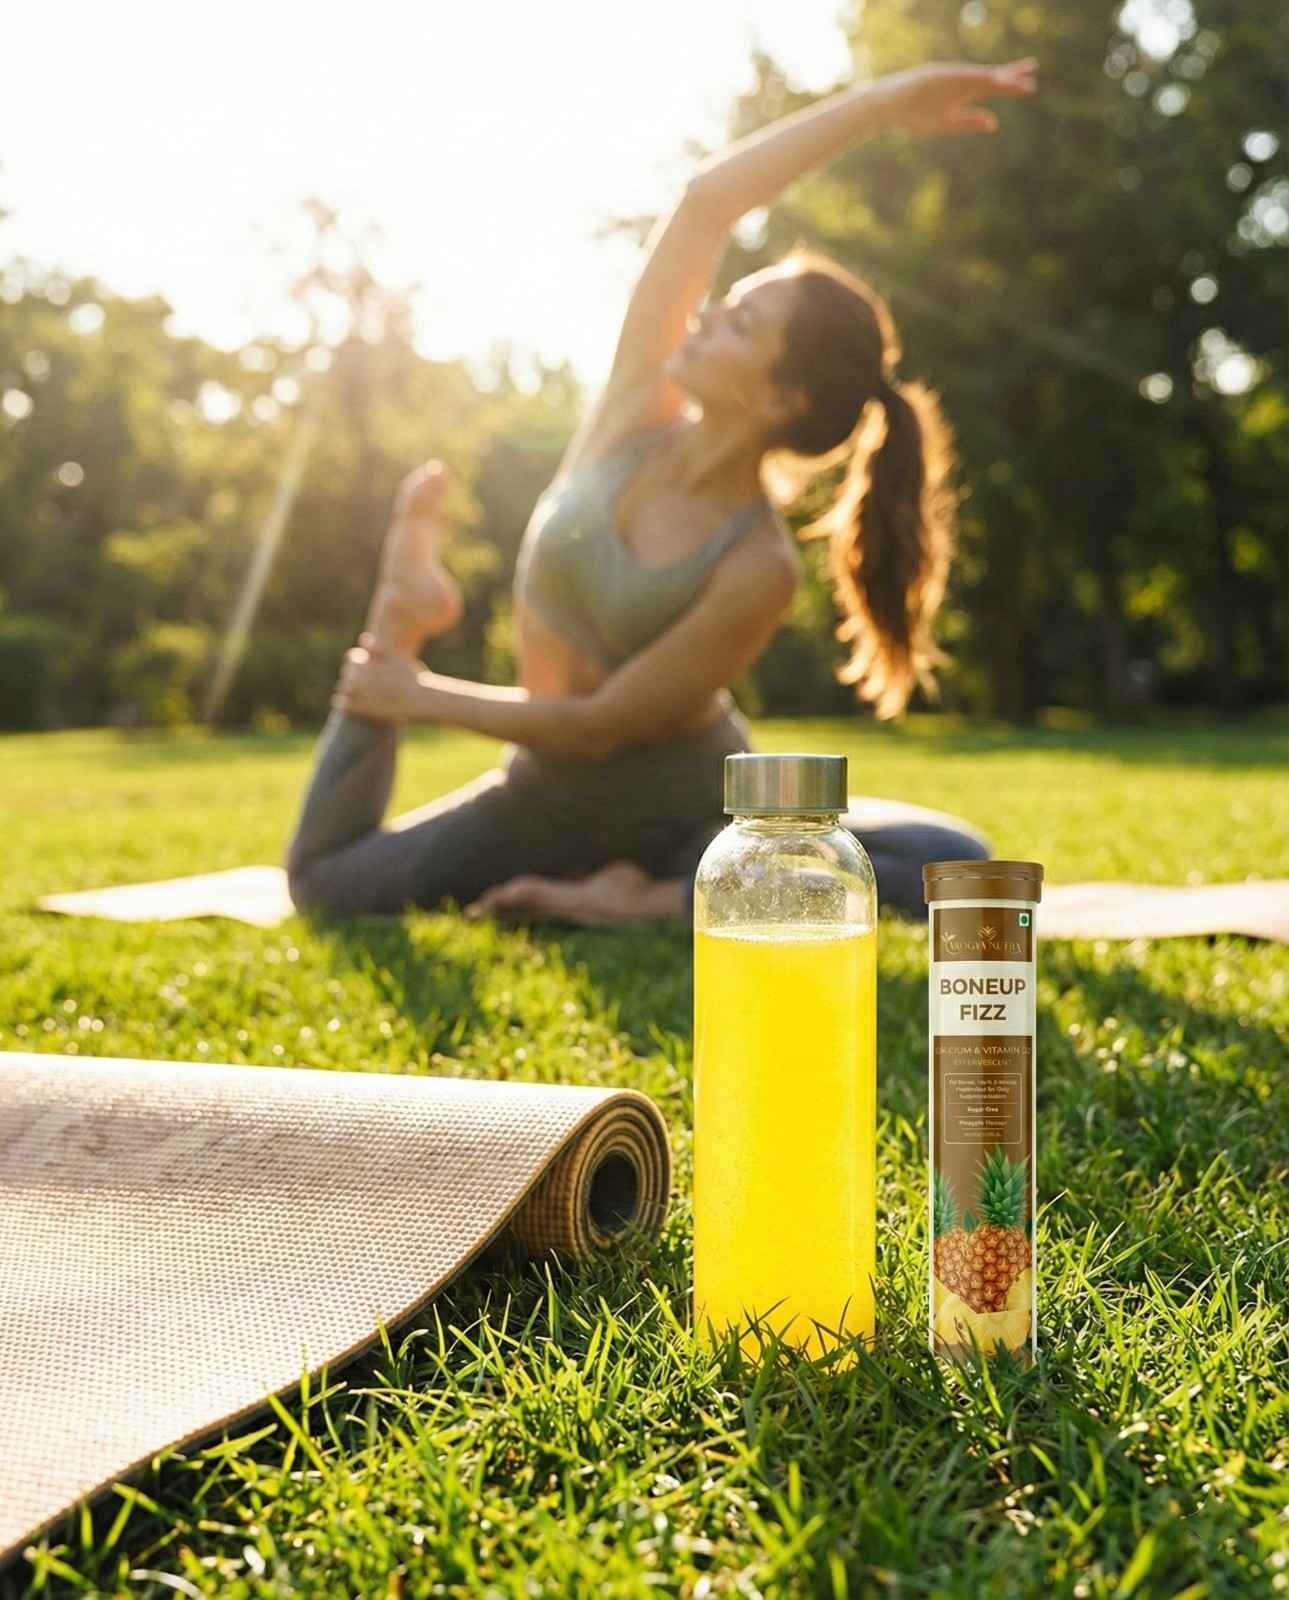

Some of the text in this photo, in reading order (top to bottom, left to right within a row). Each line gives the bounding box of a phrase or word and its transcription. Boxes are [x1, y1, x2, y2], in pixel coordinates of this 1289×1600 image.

[940, 978, 1026, 995] BONEUP
[960, 1004, 1007, 1021] FIZZ
[983, 1046, 1020, 1055] VITAMIN
